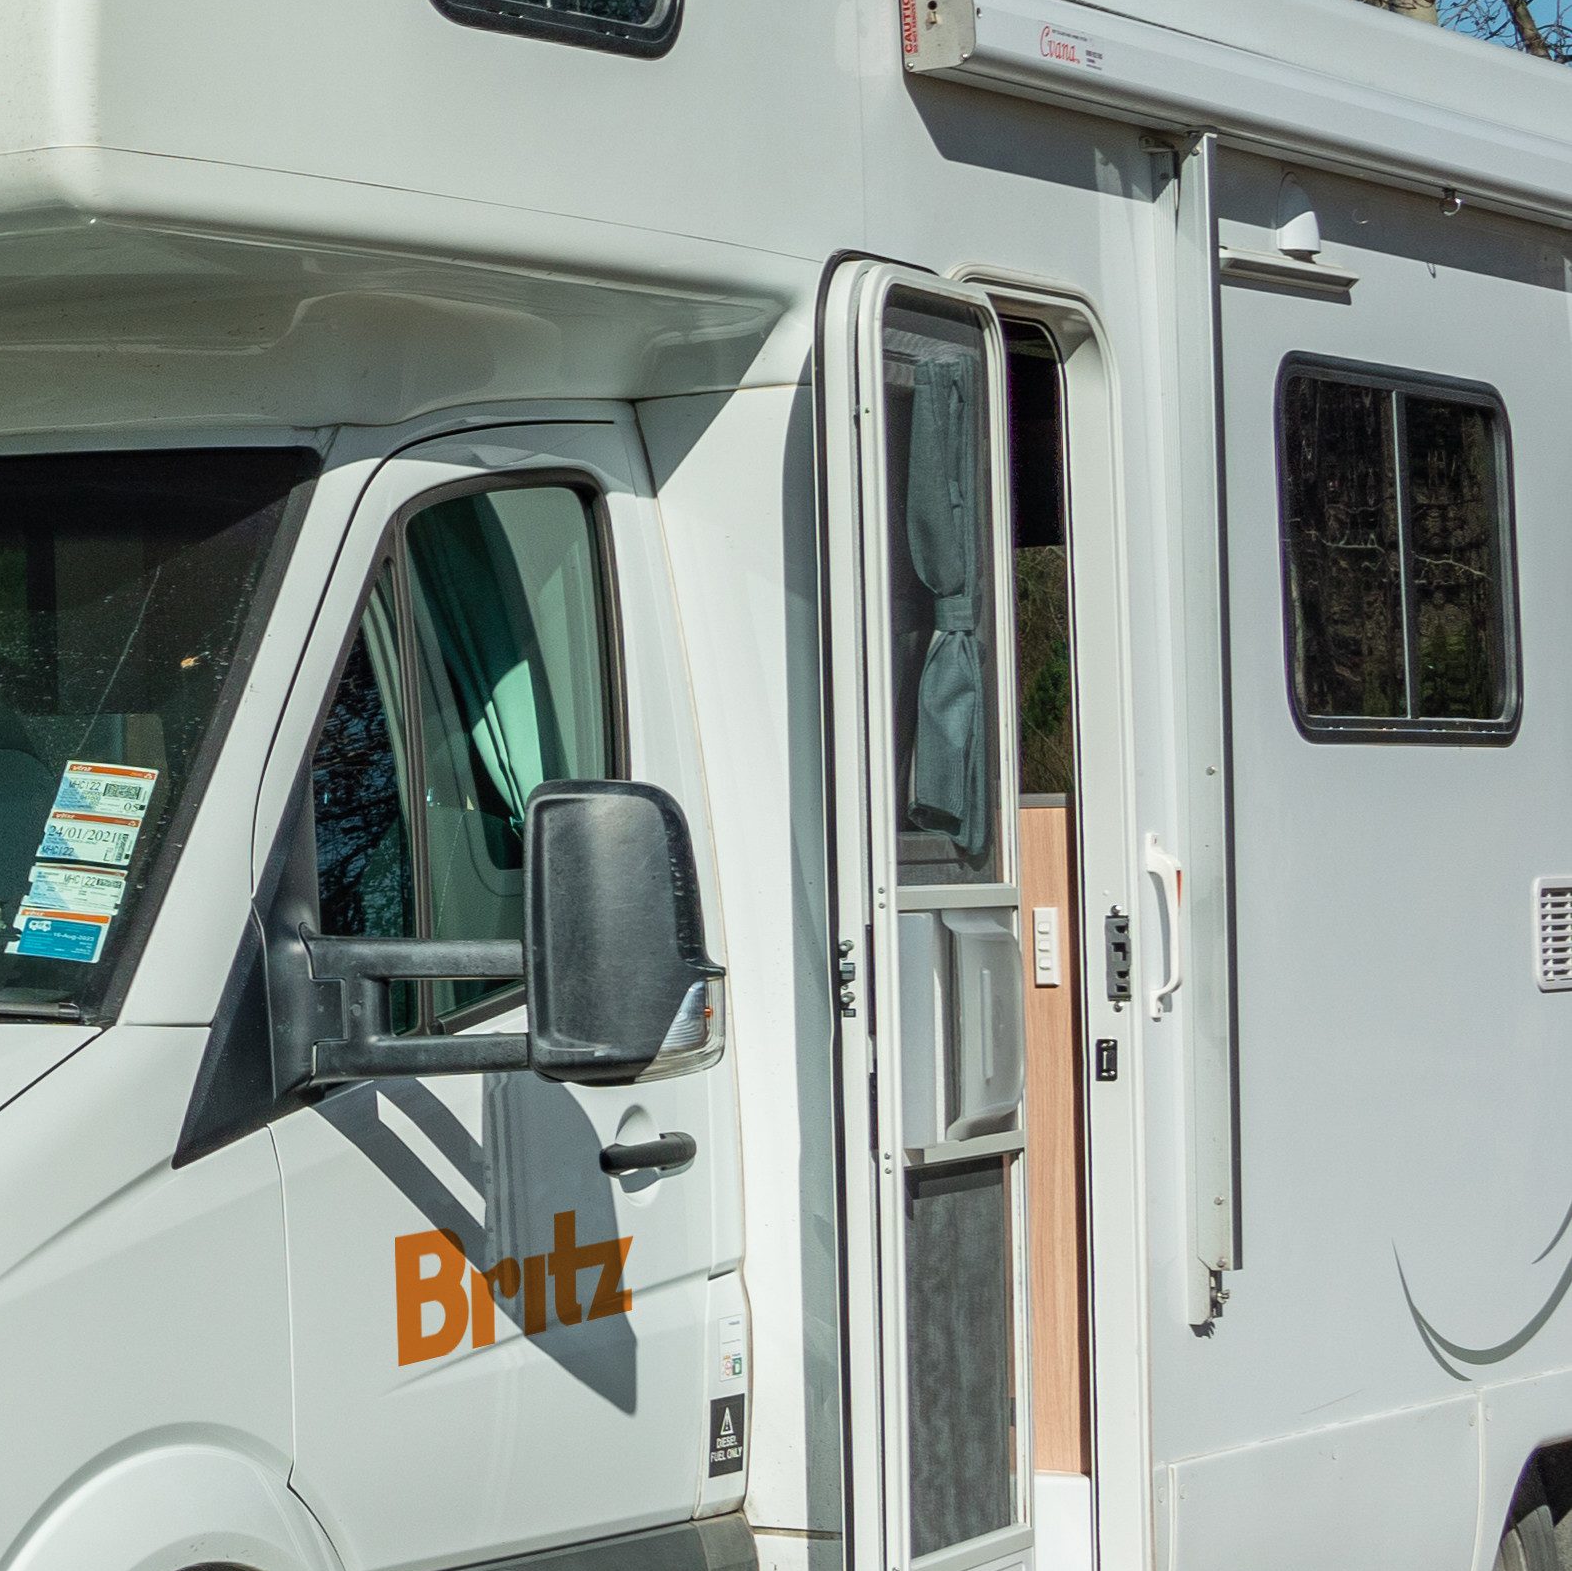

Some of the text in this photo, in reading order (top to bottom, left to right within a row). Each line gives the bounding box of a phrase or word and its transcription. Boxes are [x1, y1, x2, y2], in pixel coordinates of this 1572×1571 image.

[48, 825, 117, 843] 24/01/2021
[395, 1209, 634, 1367] Britz
[716, 1436, 738, 1449] DIESEL
[710, 1446, 743, 1463] FUEL ONLY
